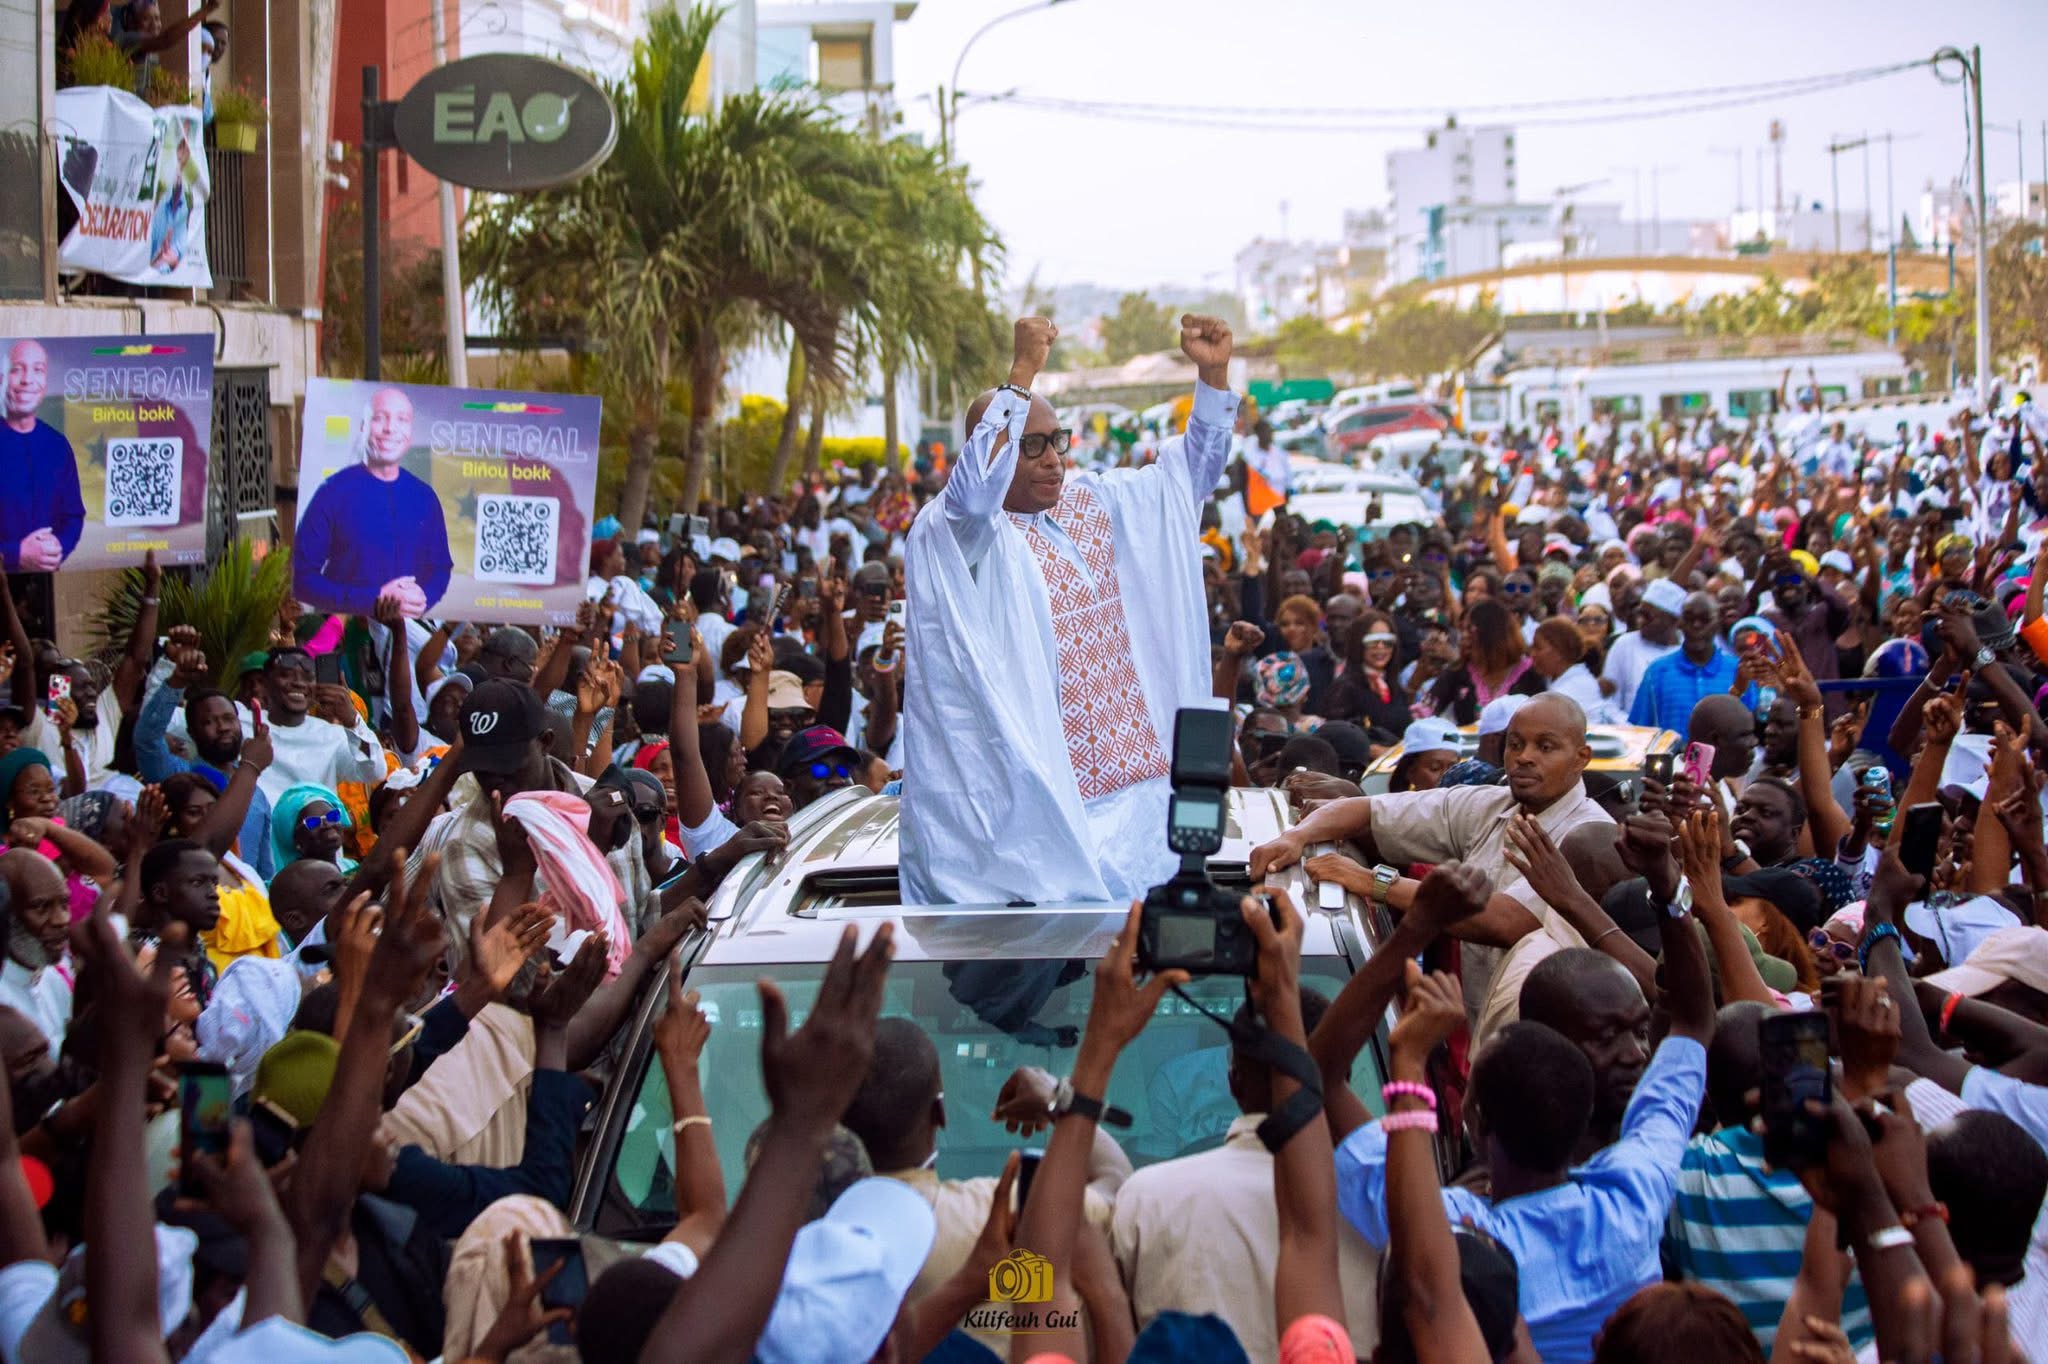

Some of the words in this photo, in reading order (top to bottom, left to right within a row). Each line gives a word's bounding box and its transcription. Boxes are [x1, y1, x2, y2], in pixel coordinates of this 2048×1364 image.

[64, 366, 209, 404] SENEGAL
[93, 405, 135, 423] Biñou
[139, 404, 175, 422] bokk
[430, 420, 588, 462] SENEGAL
[463, 460, 507, 480] Biñou
[512, 464, 551, 480] bokk
[470, 711, 499, 735] W
